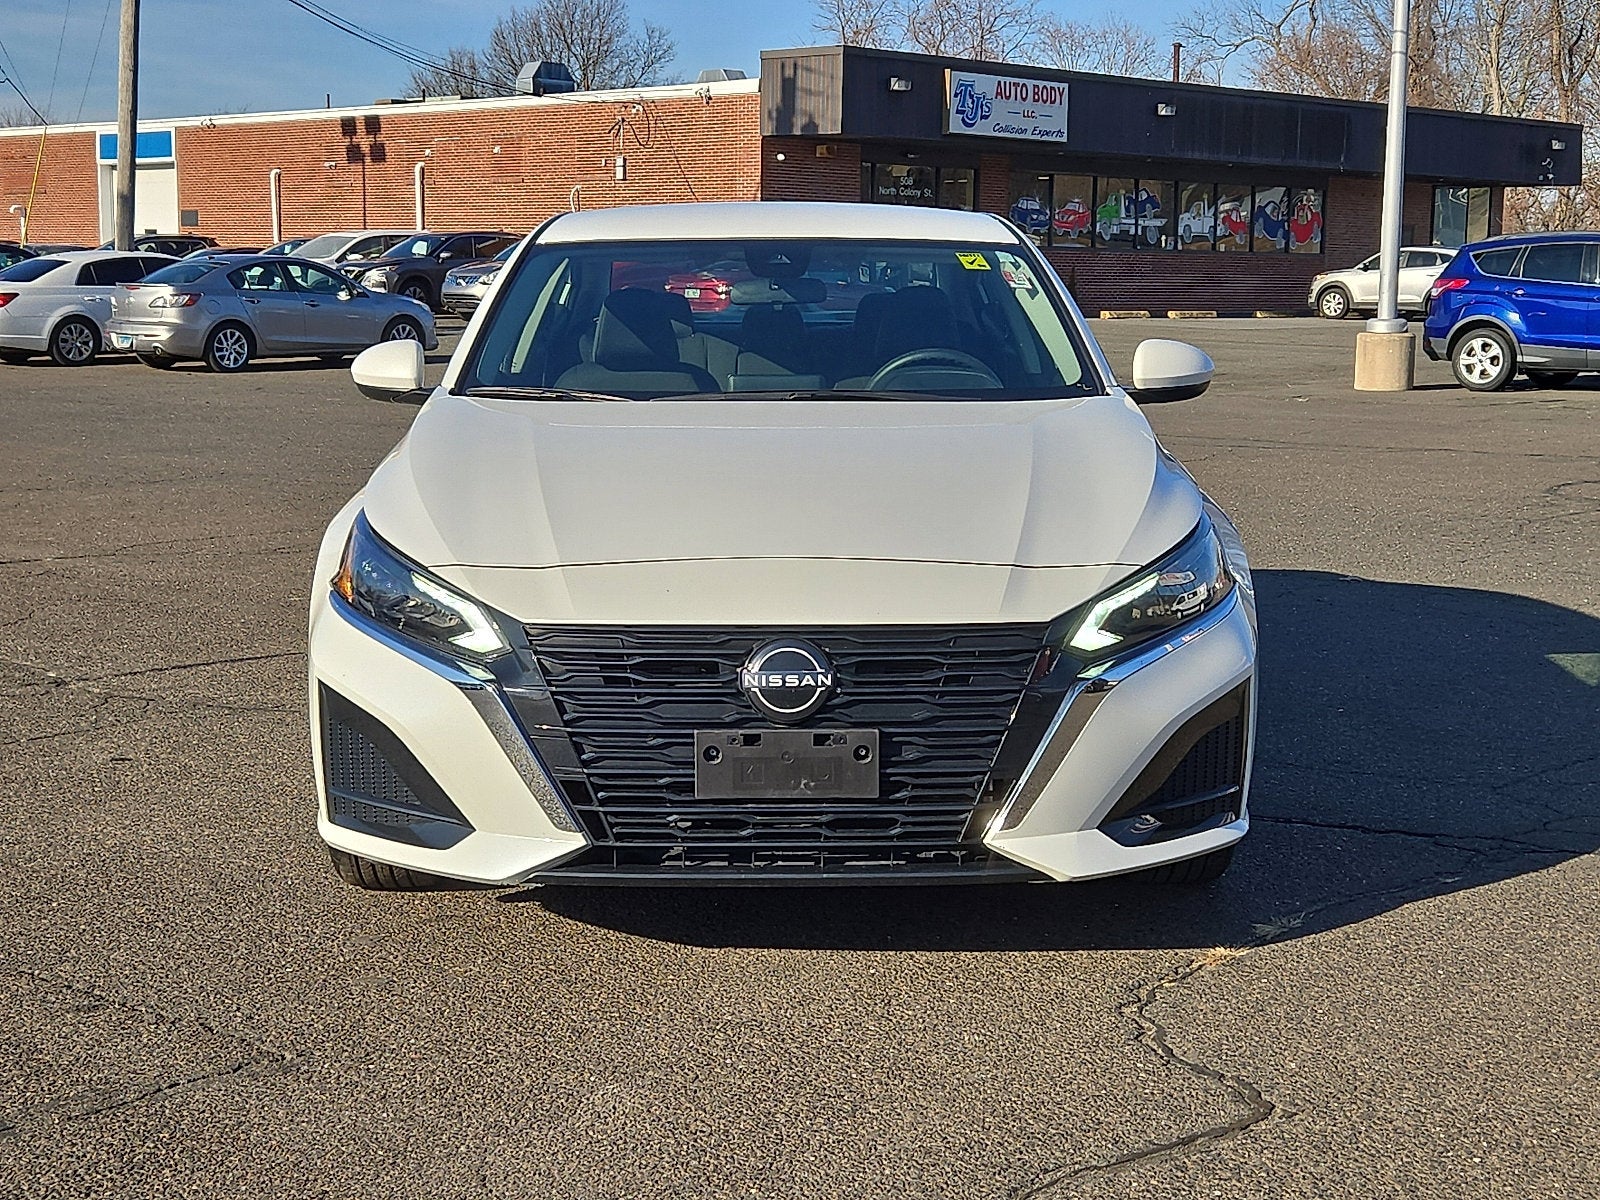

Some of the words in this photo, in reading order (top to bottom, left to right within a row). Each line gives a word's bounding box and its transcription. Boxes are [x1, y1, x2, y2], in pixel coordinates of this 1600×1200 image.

[995, 80, 1029, 102] AUTO
[1032, 84, 1065, 105] BODY
[992, 122, 1027, 135] Collision
[1031, 126, 1065, 138] Experts
[900, 176, 914, 186] 508
[879, 186, 897, 195] North
[899, 187, 922, 198] Colony
[744, 673, 832, 687] NISSAN
